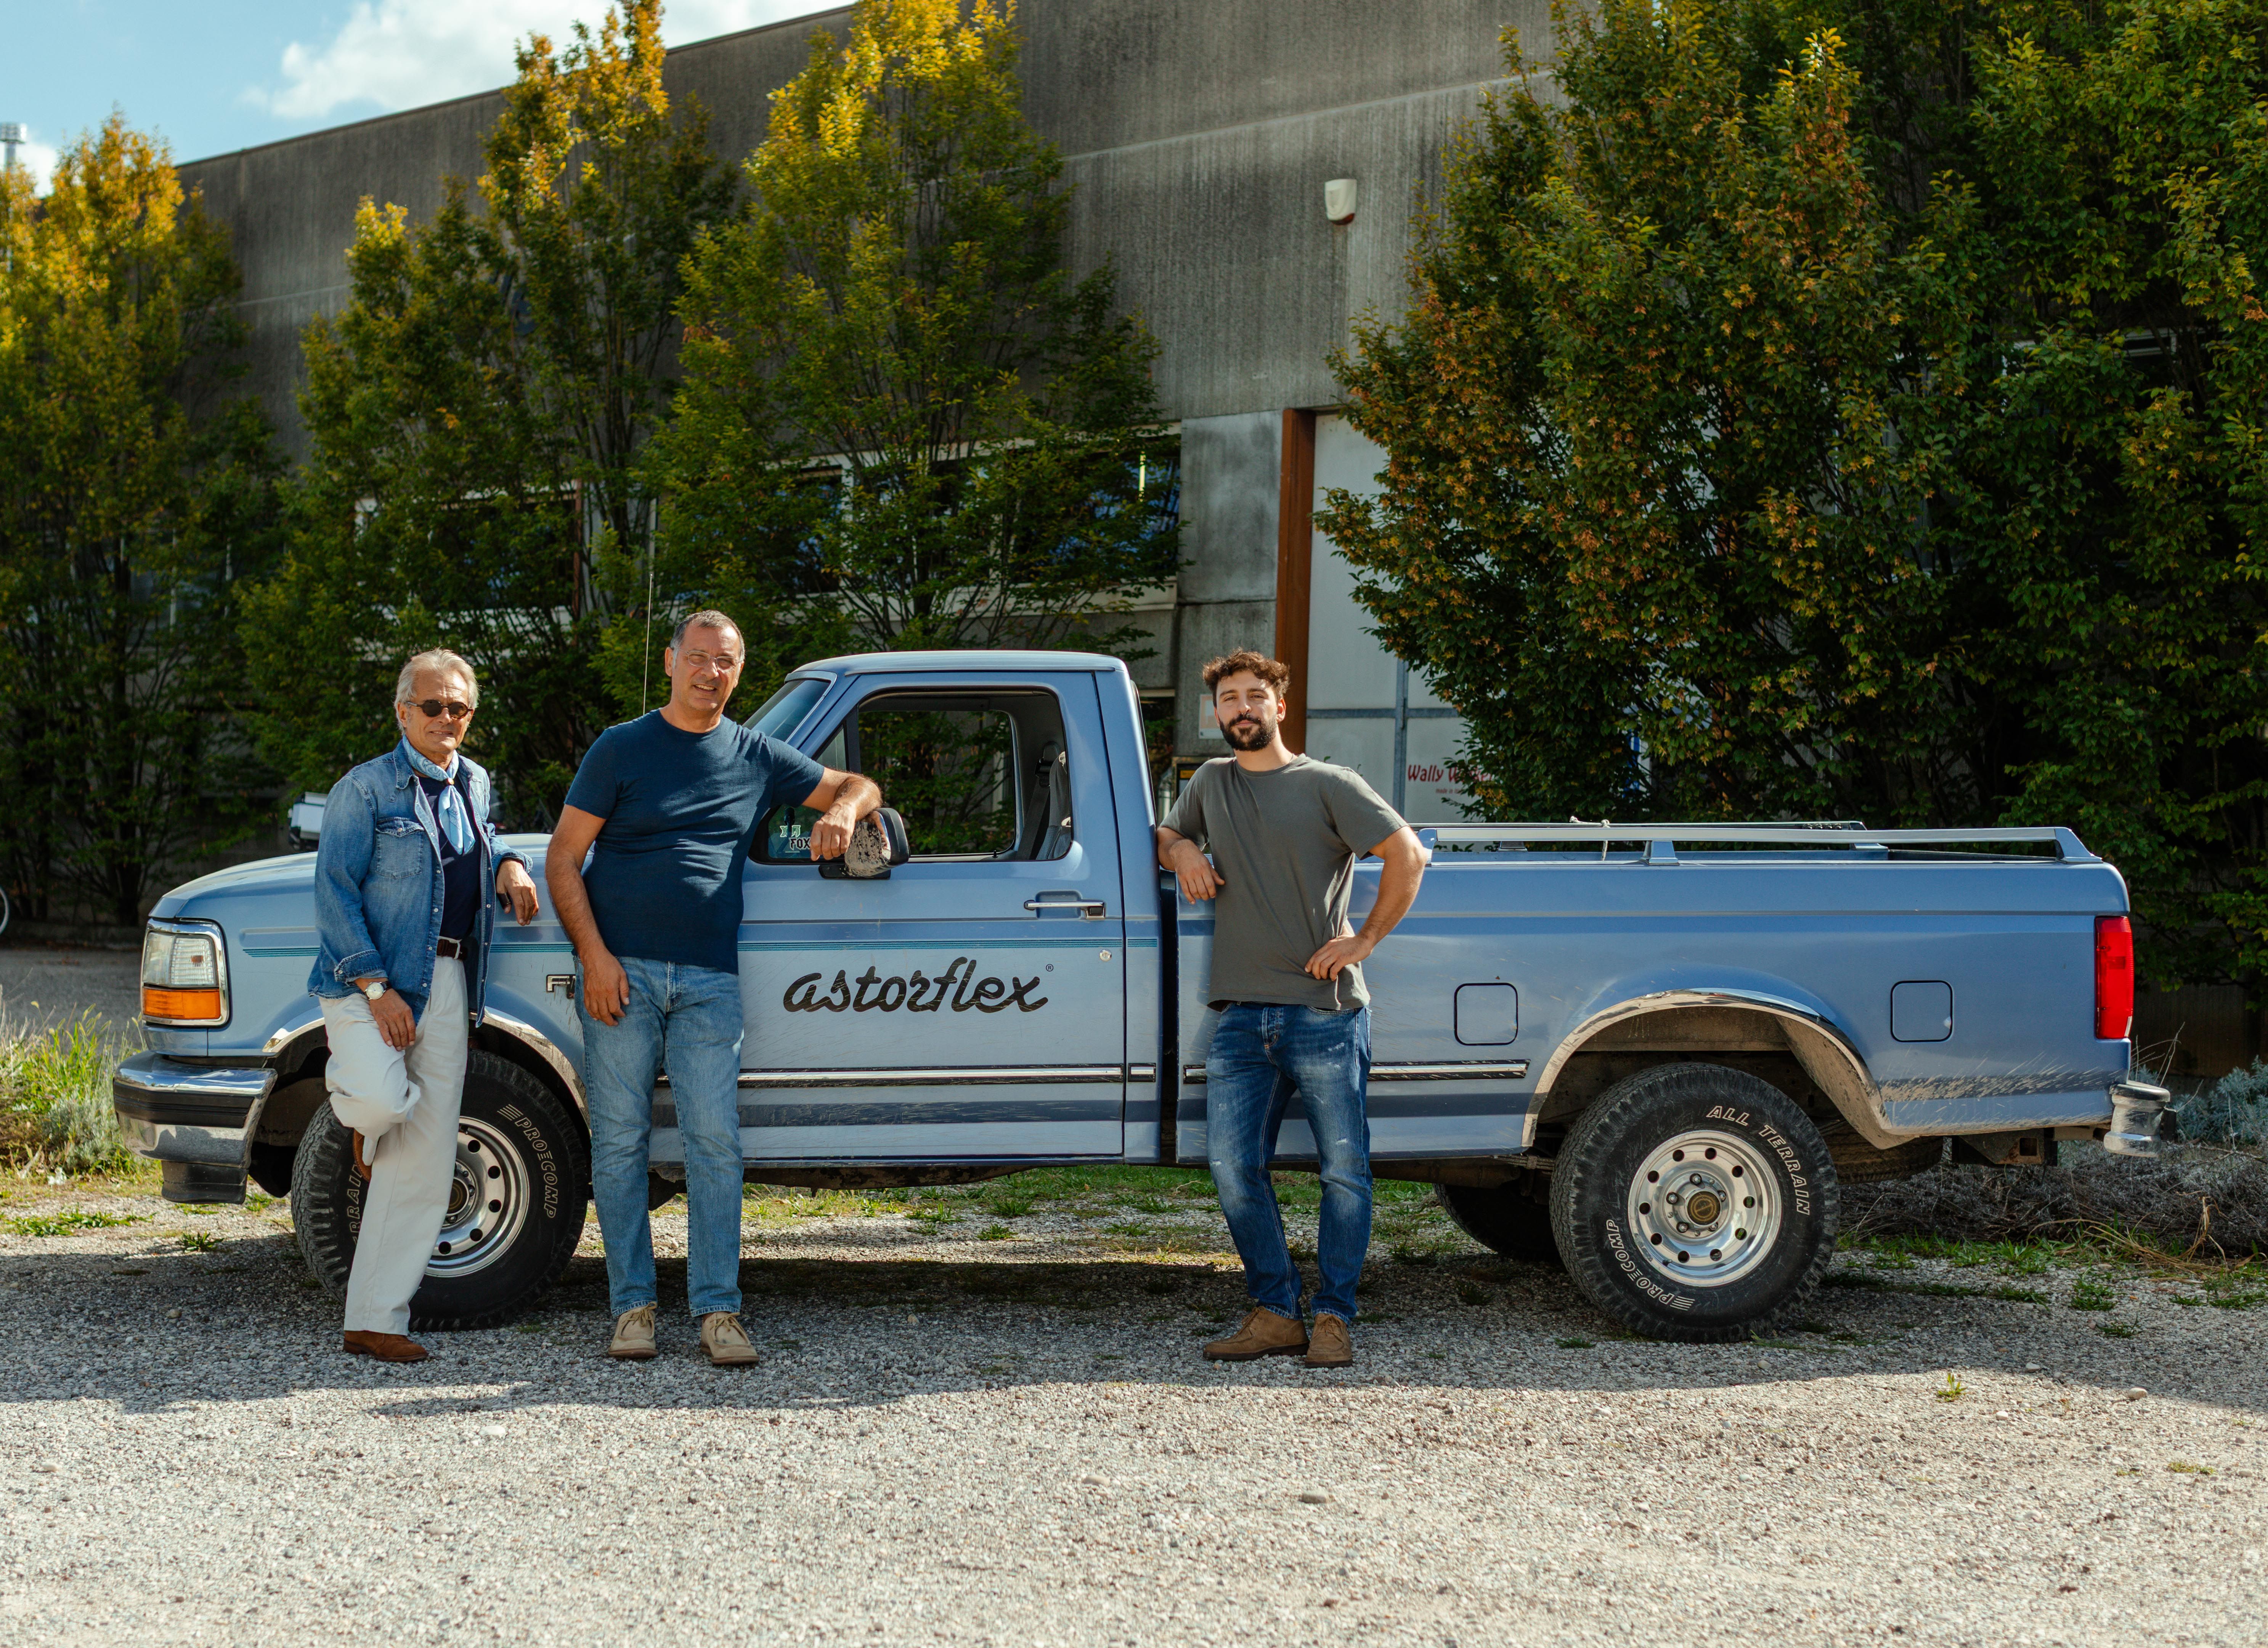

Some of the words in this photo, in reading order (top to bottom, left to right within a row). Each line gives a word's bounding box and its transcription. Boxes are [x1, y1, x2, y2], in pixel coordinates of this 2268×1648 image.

[1408, 764, 1444, 782] Wally
[789, 837, 811, 850] FOX
[783, 957, 1048, 1013] astorflex
[1706, 1106, 1750, 1126] ALL
[1758, 1124, 1810, 1215] TERRAIN
